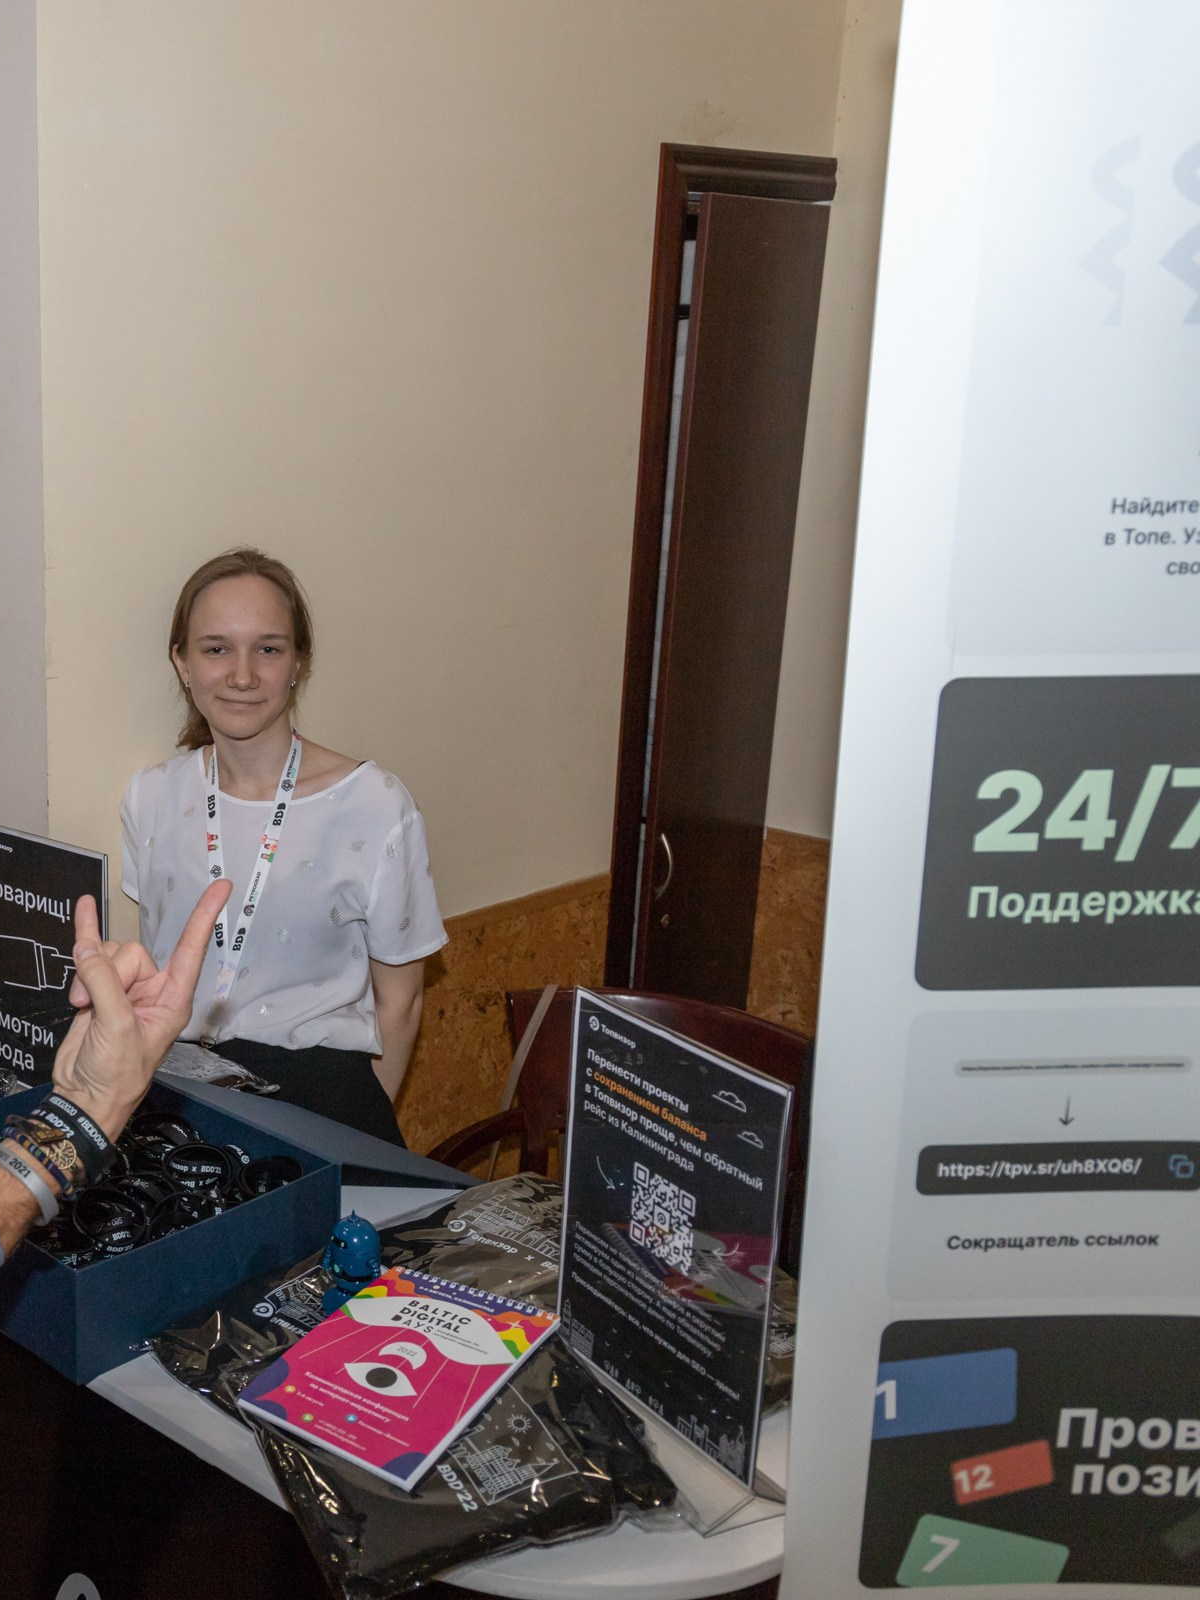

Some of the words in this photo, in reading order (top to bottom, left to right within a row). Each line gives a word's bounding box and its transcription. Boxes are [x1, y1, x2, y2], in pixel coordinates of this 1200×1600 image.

[1111, 496, 1200, 517] Найдите
[1104, 531, 1117, 546] в
[1123, 527, 1177, 546] Топе.
[973, 764, 1200, 862] 24/7
[249, 871, 262, 902] PETROGRAD
[967, 885, 1200, 924] Поддержк
[600, 1023, 636, 1050] Топвизор
[586, 1047, 641, 1087] Перенести
[642, 1079, 689, 1113] проекты
[593, 1070, 660, 1115] сохранением
[660, 1106, 708, 1141] баланса
[583, 1098, 606, 1120] рейс
[608, 1114, 619, 1127] из
[620, 1119, 695, 1173] Калининграда
[592, 1085, 638, 1123] Топвизор
[639, 1115, 678, 1146] проще,
[679, 1138, 702, 1158] чем
[703, 1149, 764, 1191] обратный
[9, 1157, 31, 1178] 2021
[466, 1228, 519, 1254] Топвизор
[947, 1234, 1080, 1252] Сокращатель
[1084, 1233, 1160, 1247] ссылок
[618, 1251, 640, 1272] только
[389, 1313, 435, 1334] DAYS
[398, 1306, 465, 1333] DIGITAL
[407, 1299, 473, 1325] BALTIC
[395, 1345, 418, 1357] 2022
[302, 1370, 363, 1401] Калининградская
[359, 1397, 410, 1423] конференция
[317, 1386, 392, 1424] интернет-маркетингу
[436, 1464, 479, 1513] BDD'22
[954, 1464, 993, 1494] 12
[921, 1533, 961, 1574] 7
